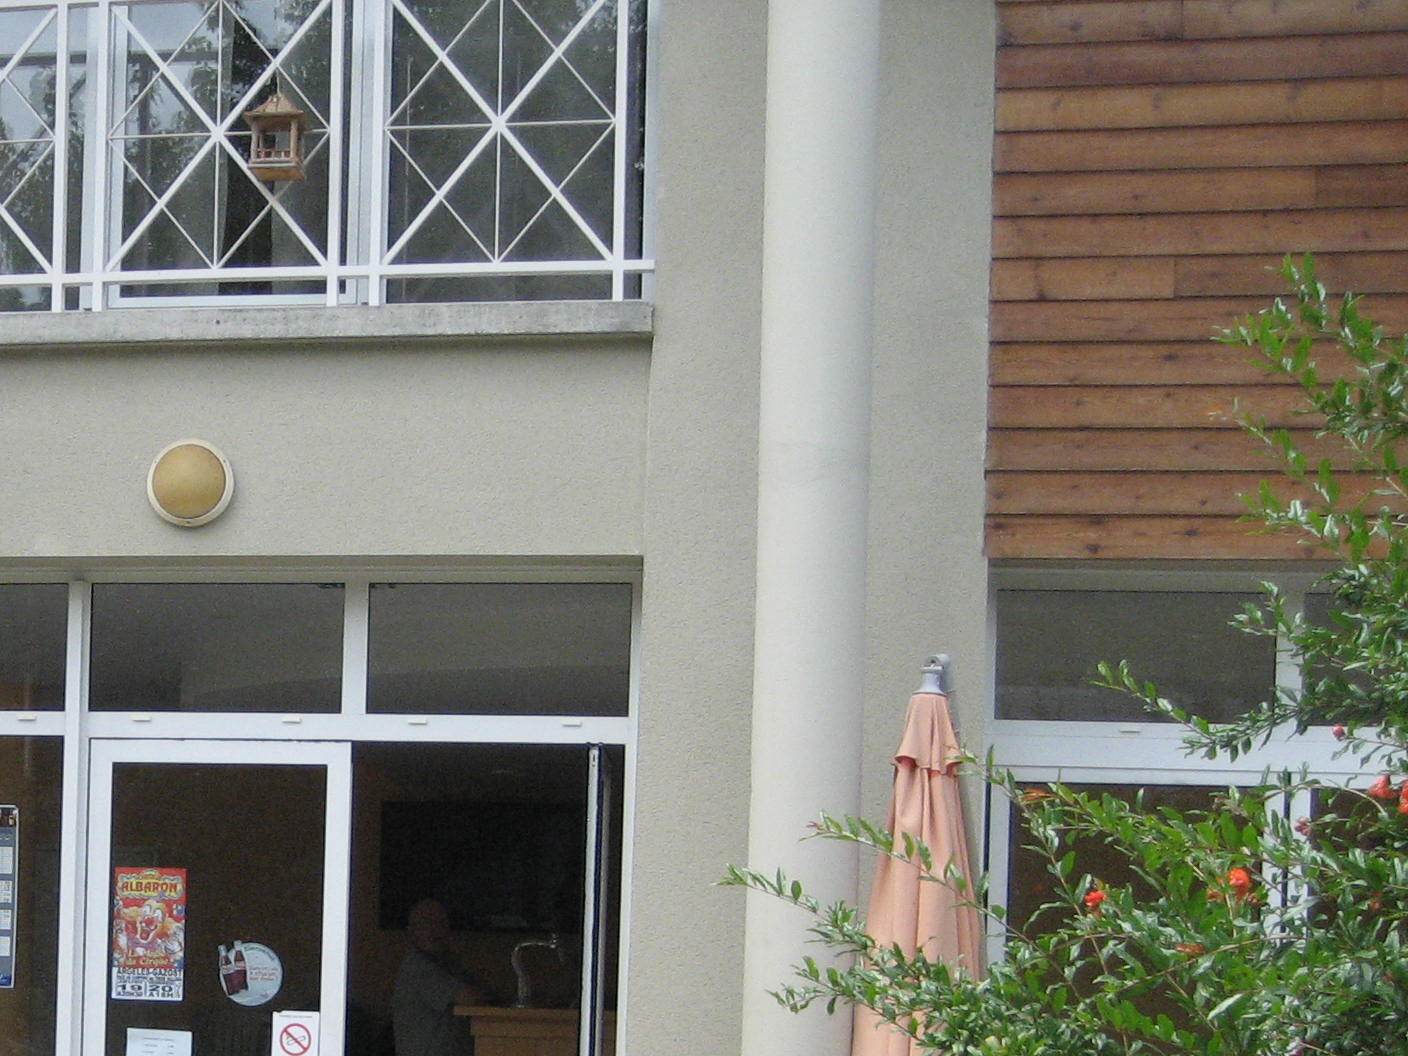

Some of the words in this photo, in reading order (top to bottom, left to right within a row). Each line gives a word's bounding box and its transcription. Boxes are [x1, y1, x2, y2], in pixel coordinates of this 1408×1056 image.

[121, 880, 178, 894] ALBARON
[117, 983, 143, 992] 19
[148, 983, 173, 993] 20
